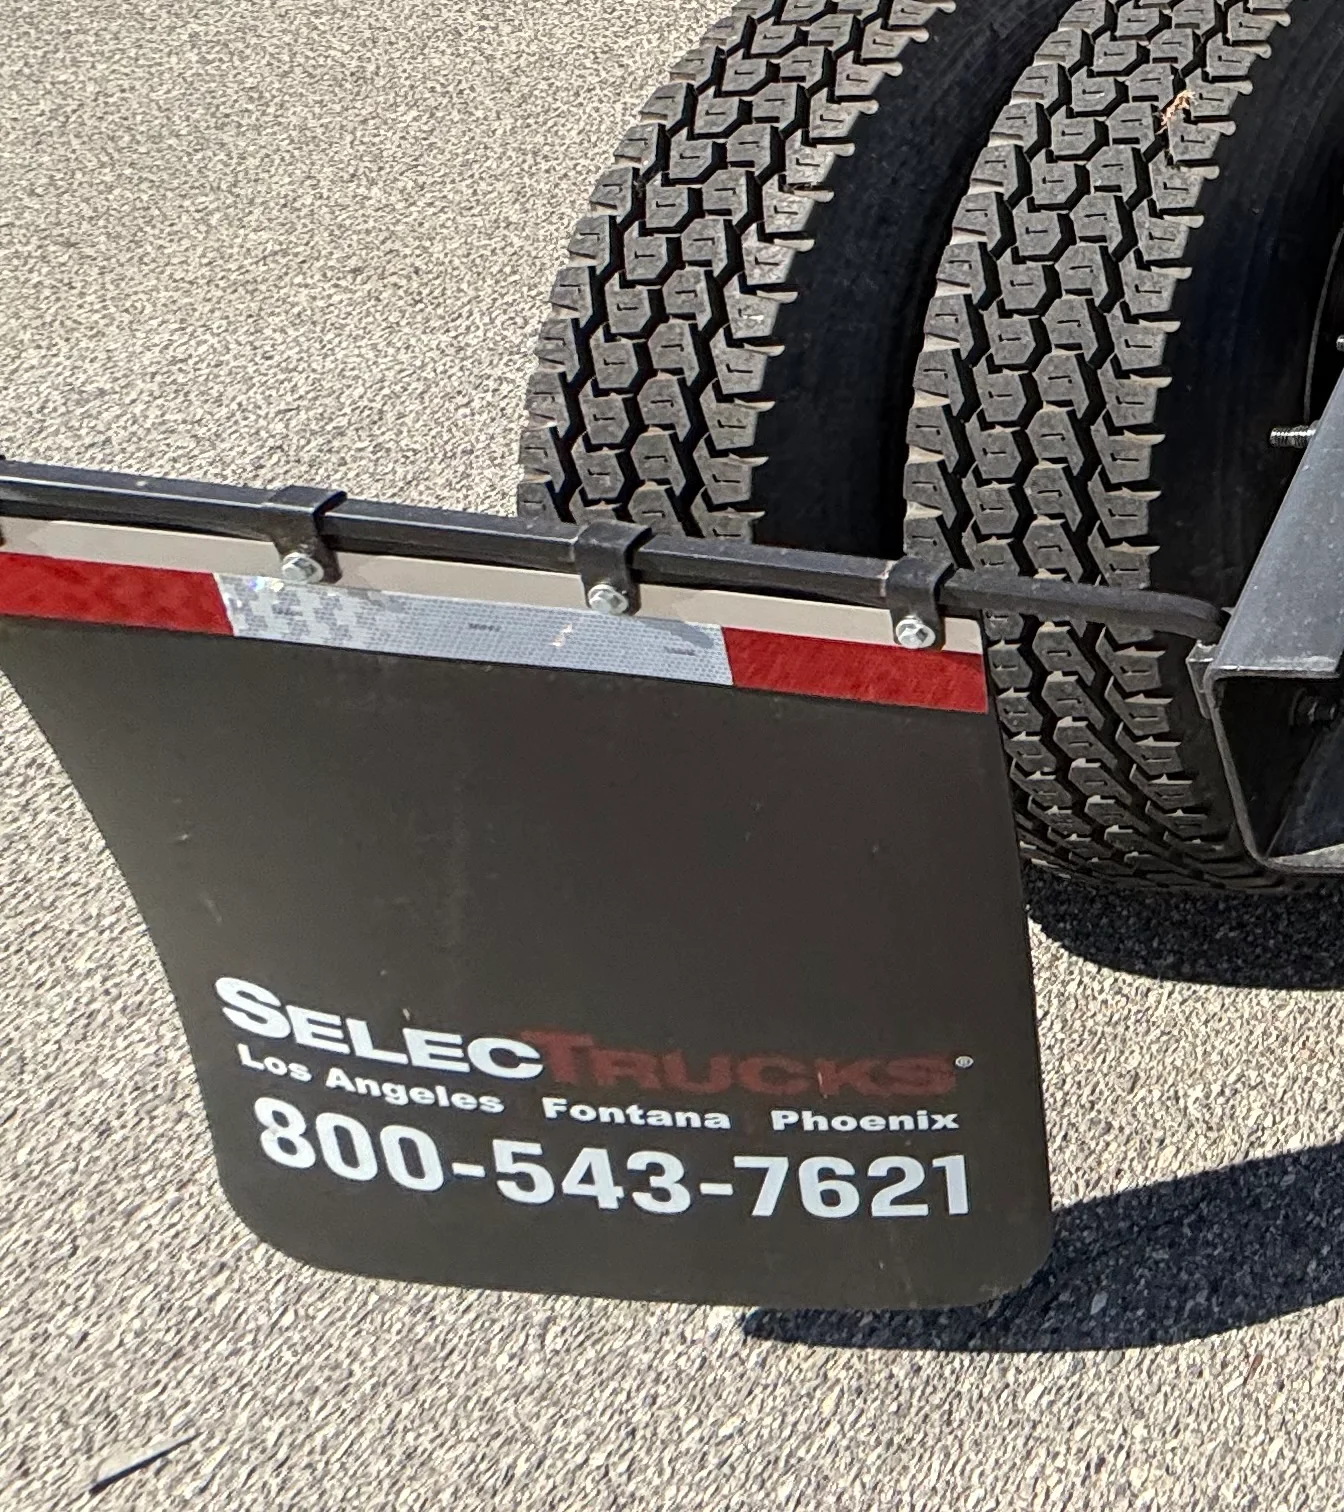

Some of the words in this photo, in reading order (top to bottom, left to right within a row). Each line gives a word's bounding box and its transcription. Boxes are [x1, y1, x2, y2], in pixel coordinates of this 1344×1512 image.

[237, 1042, 313, 1083] Los
[324, 1065, 505, 1115] Angeles
[541, 1095, 732, 1131] Fontana
[770, 1108, 960, 1131] Phoenix
[252, 1095, 970, 1219] 800-543-7621
